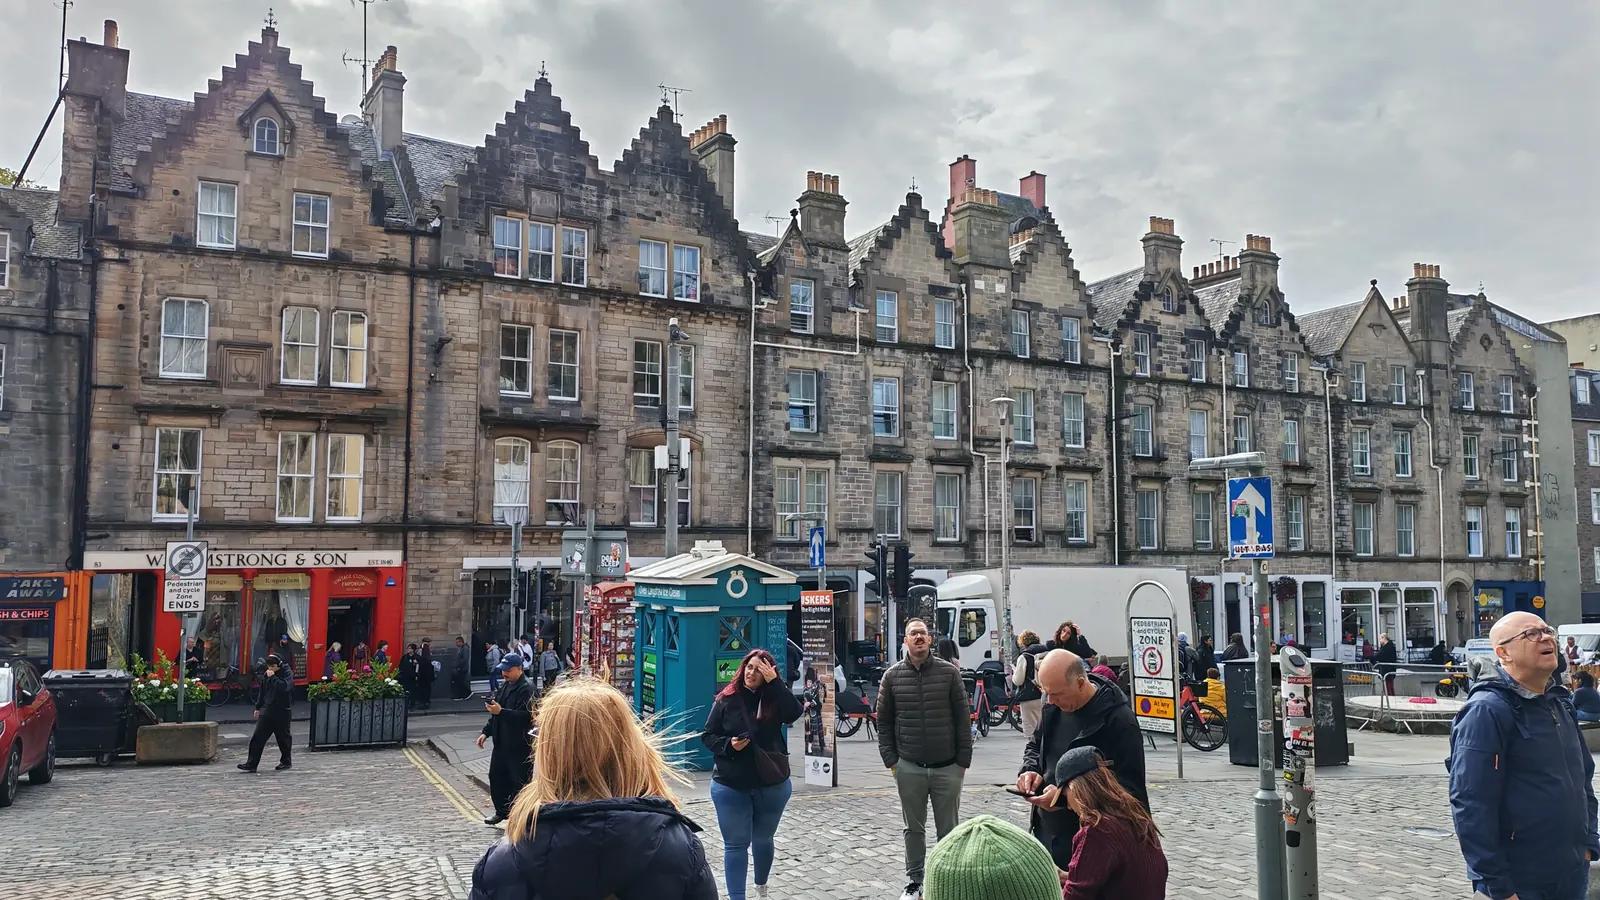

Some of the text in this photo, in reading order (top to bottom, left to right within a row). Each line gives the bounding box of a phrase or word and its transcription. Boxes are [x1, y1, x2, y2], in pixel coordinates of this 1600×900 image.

[295, 553, 306, 566] &
[313, 553, 347, 566] SON
[265, 576, 300, 585] Emporium
[6, 589, 57, 598] AWAY
[168, 600, 200, 609] ENDS
[11, 610, 19, 619] &
[20, 610, 49, 618] CHIPS
[808, 606, 820, 614] Right
[1133, 620, 1168, 628] PEDESTRIAN
[1139, 635, 1164, 646] ZONE
